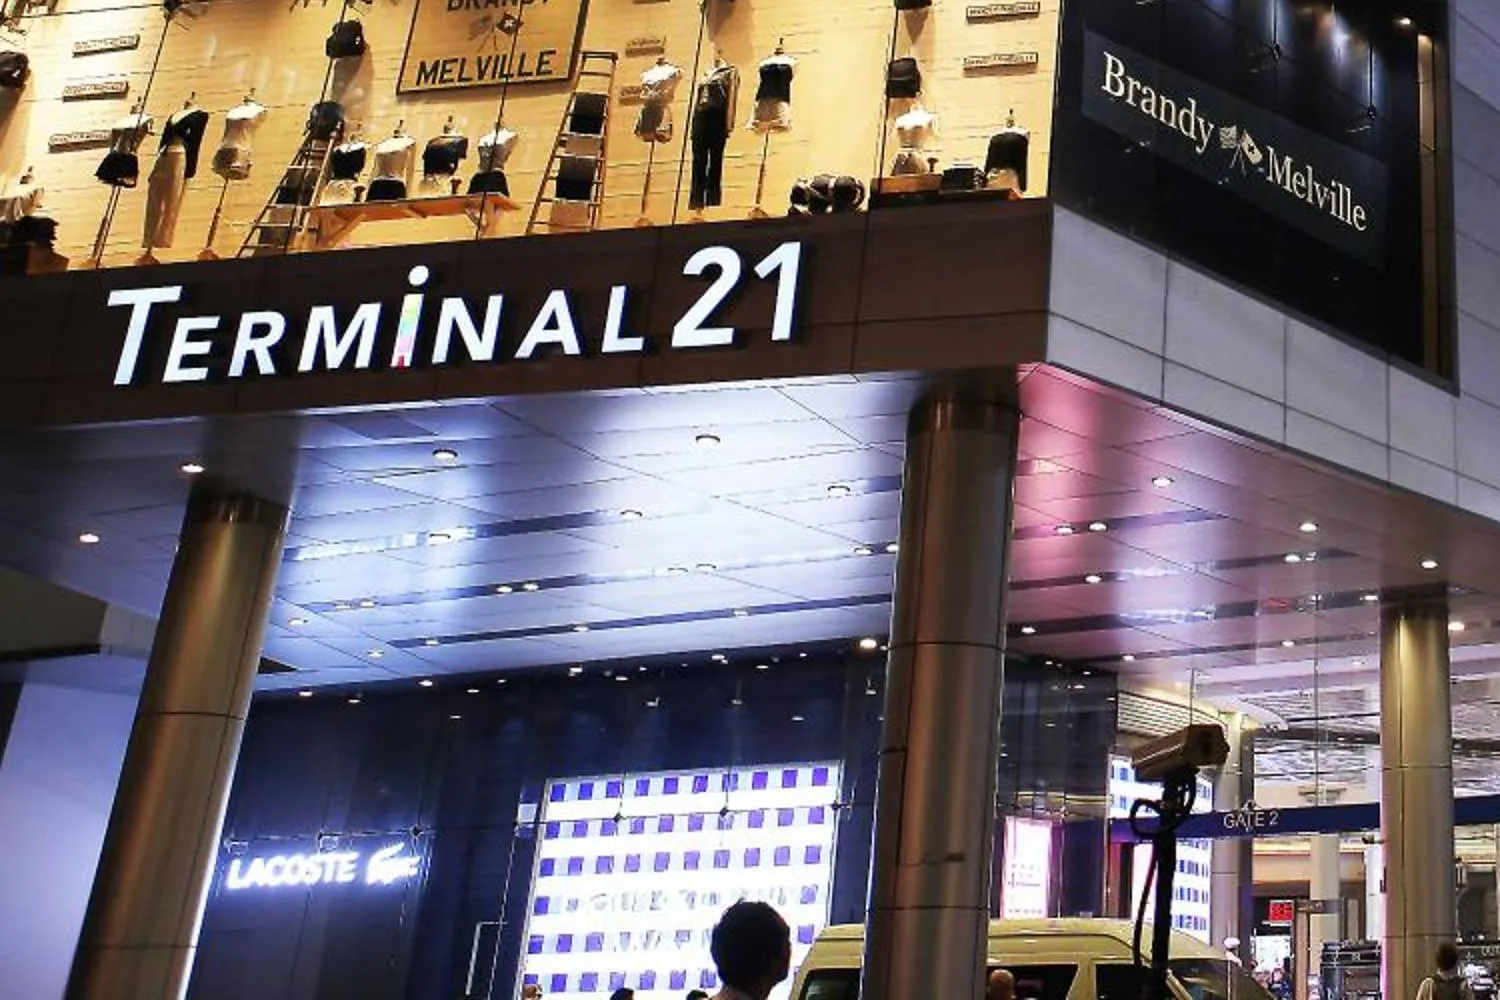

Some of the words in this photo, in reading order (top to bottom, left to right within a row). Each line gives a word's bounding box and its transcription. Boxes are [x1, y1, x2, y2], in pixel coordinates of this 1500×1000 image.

[415, 50, 556, 86] MELVILLE
[1101, 51, 1215, 154] Brandy
[1265, 146, 1368, 232] Melville
[671, 241, 801, 348] 21
[1223, 813, 1265, 829] GATE
[1269, 811, 1279, 826] 2
[227, 852, 359, 889] LACOSTE
